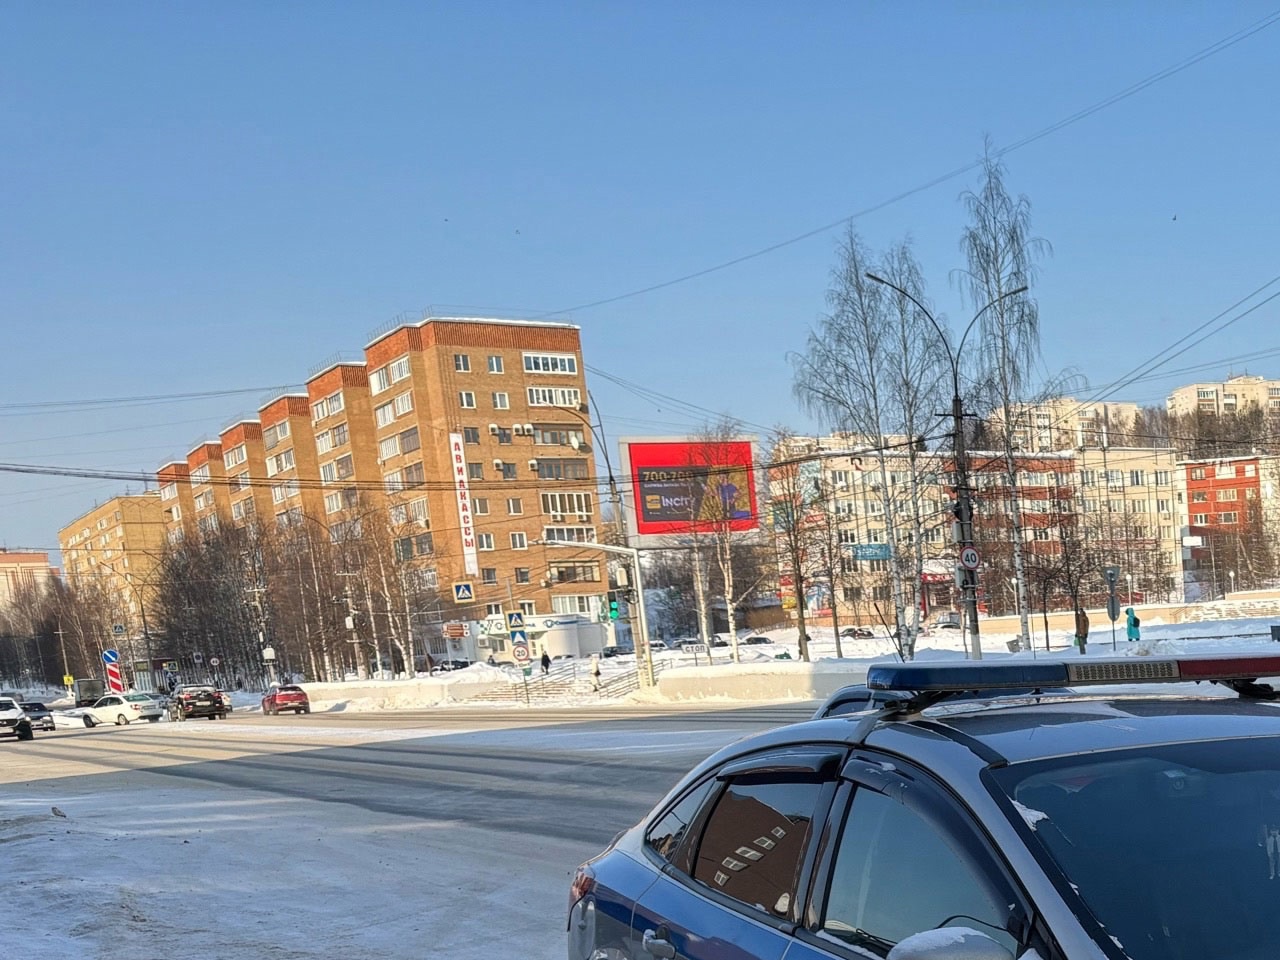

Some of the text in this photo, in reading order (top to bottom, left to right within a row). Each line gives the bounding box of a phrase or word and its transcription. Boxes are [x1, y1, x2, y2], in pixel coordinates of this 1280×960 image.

[454, 442, 474, 548] АВИАКАССЫ
[964, 553, 977, 564] 40
[516, 649, 526, 657] 20
[685, 645, 705, 653] СТОП
